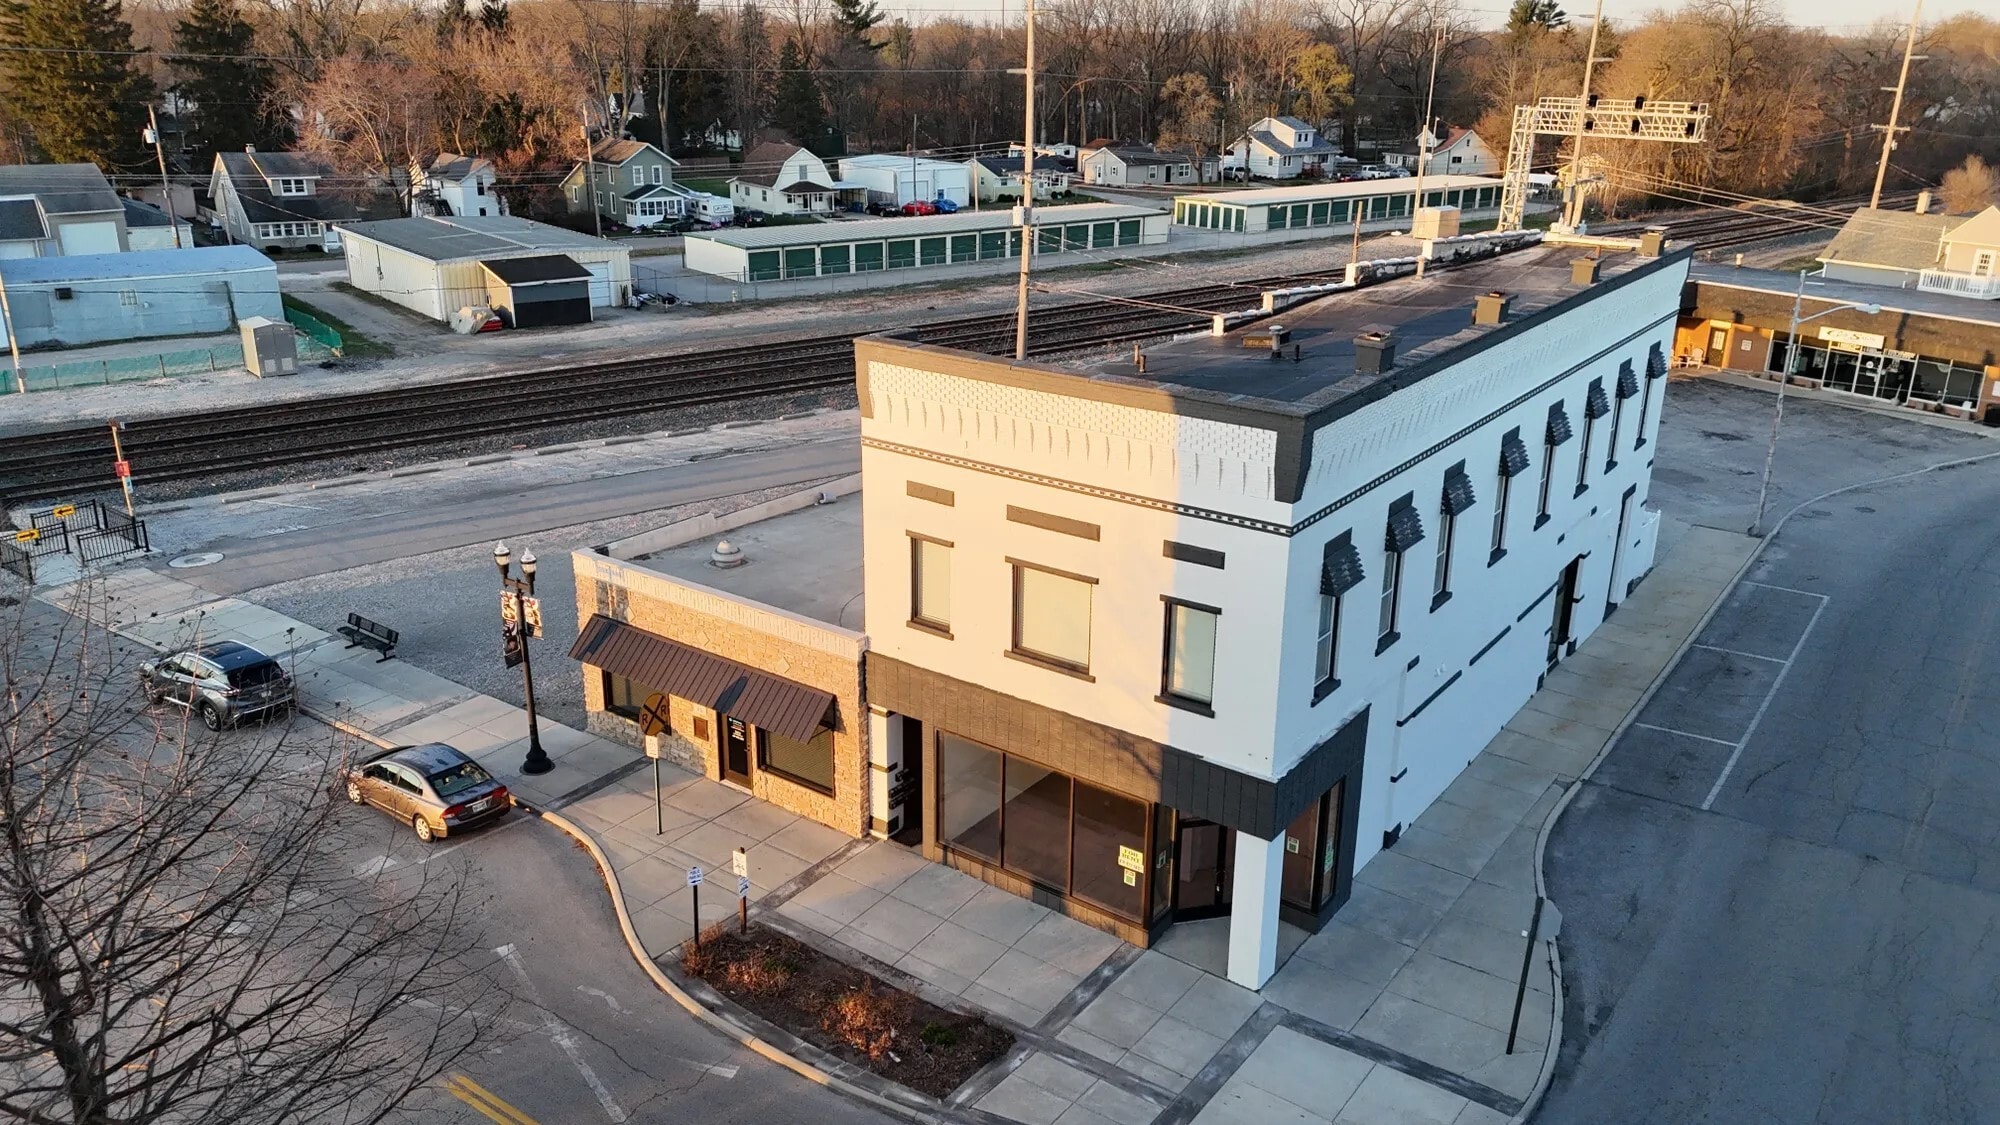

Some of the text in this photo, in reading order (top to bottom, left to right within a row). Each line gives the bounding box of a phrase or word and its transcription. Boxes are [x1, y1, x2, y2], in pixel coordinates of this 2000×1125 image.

[642, 705, 667, 725] R R
[1122, 853, 1140, 863] RENT
[1124, 849, 1138, 858] FOR
